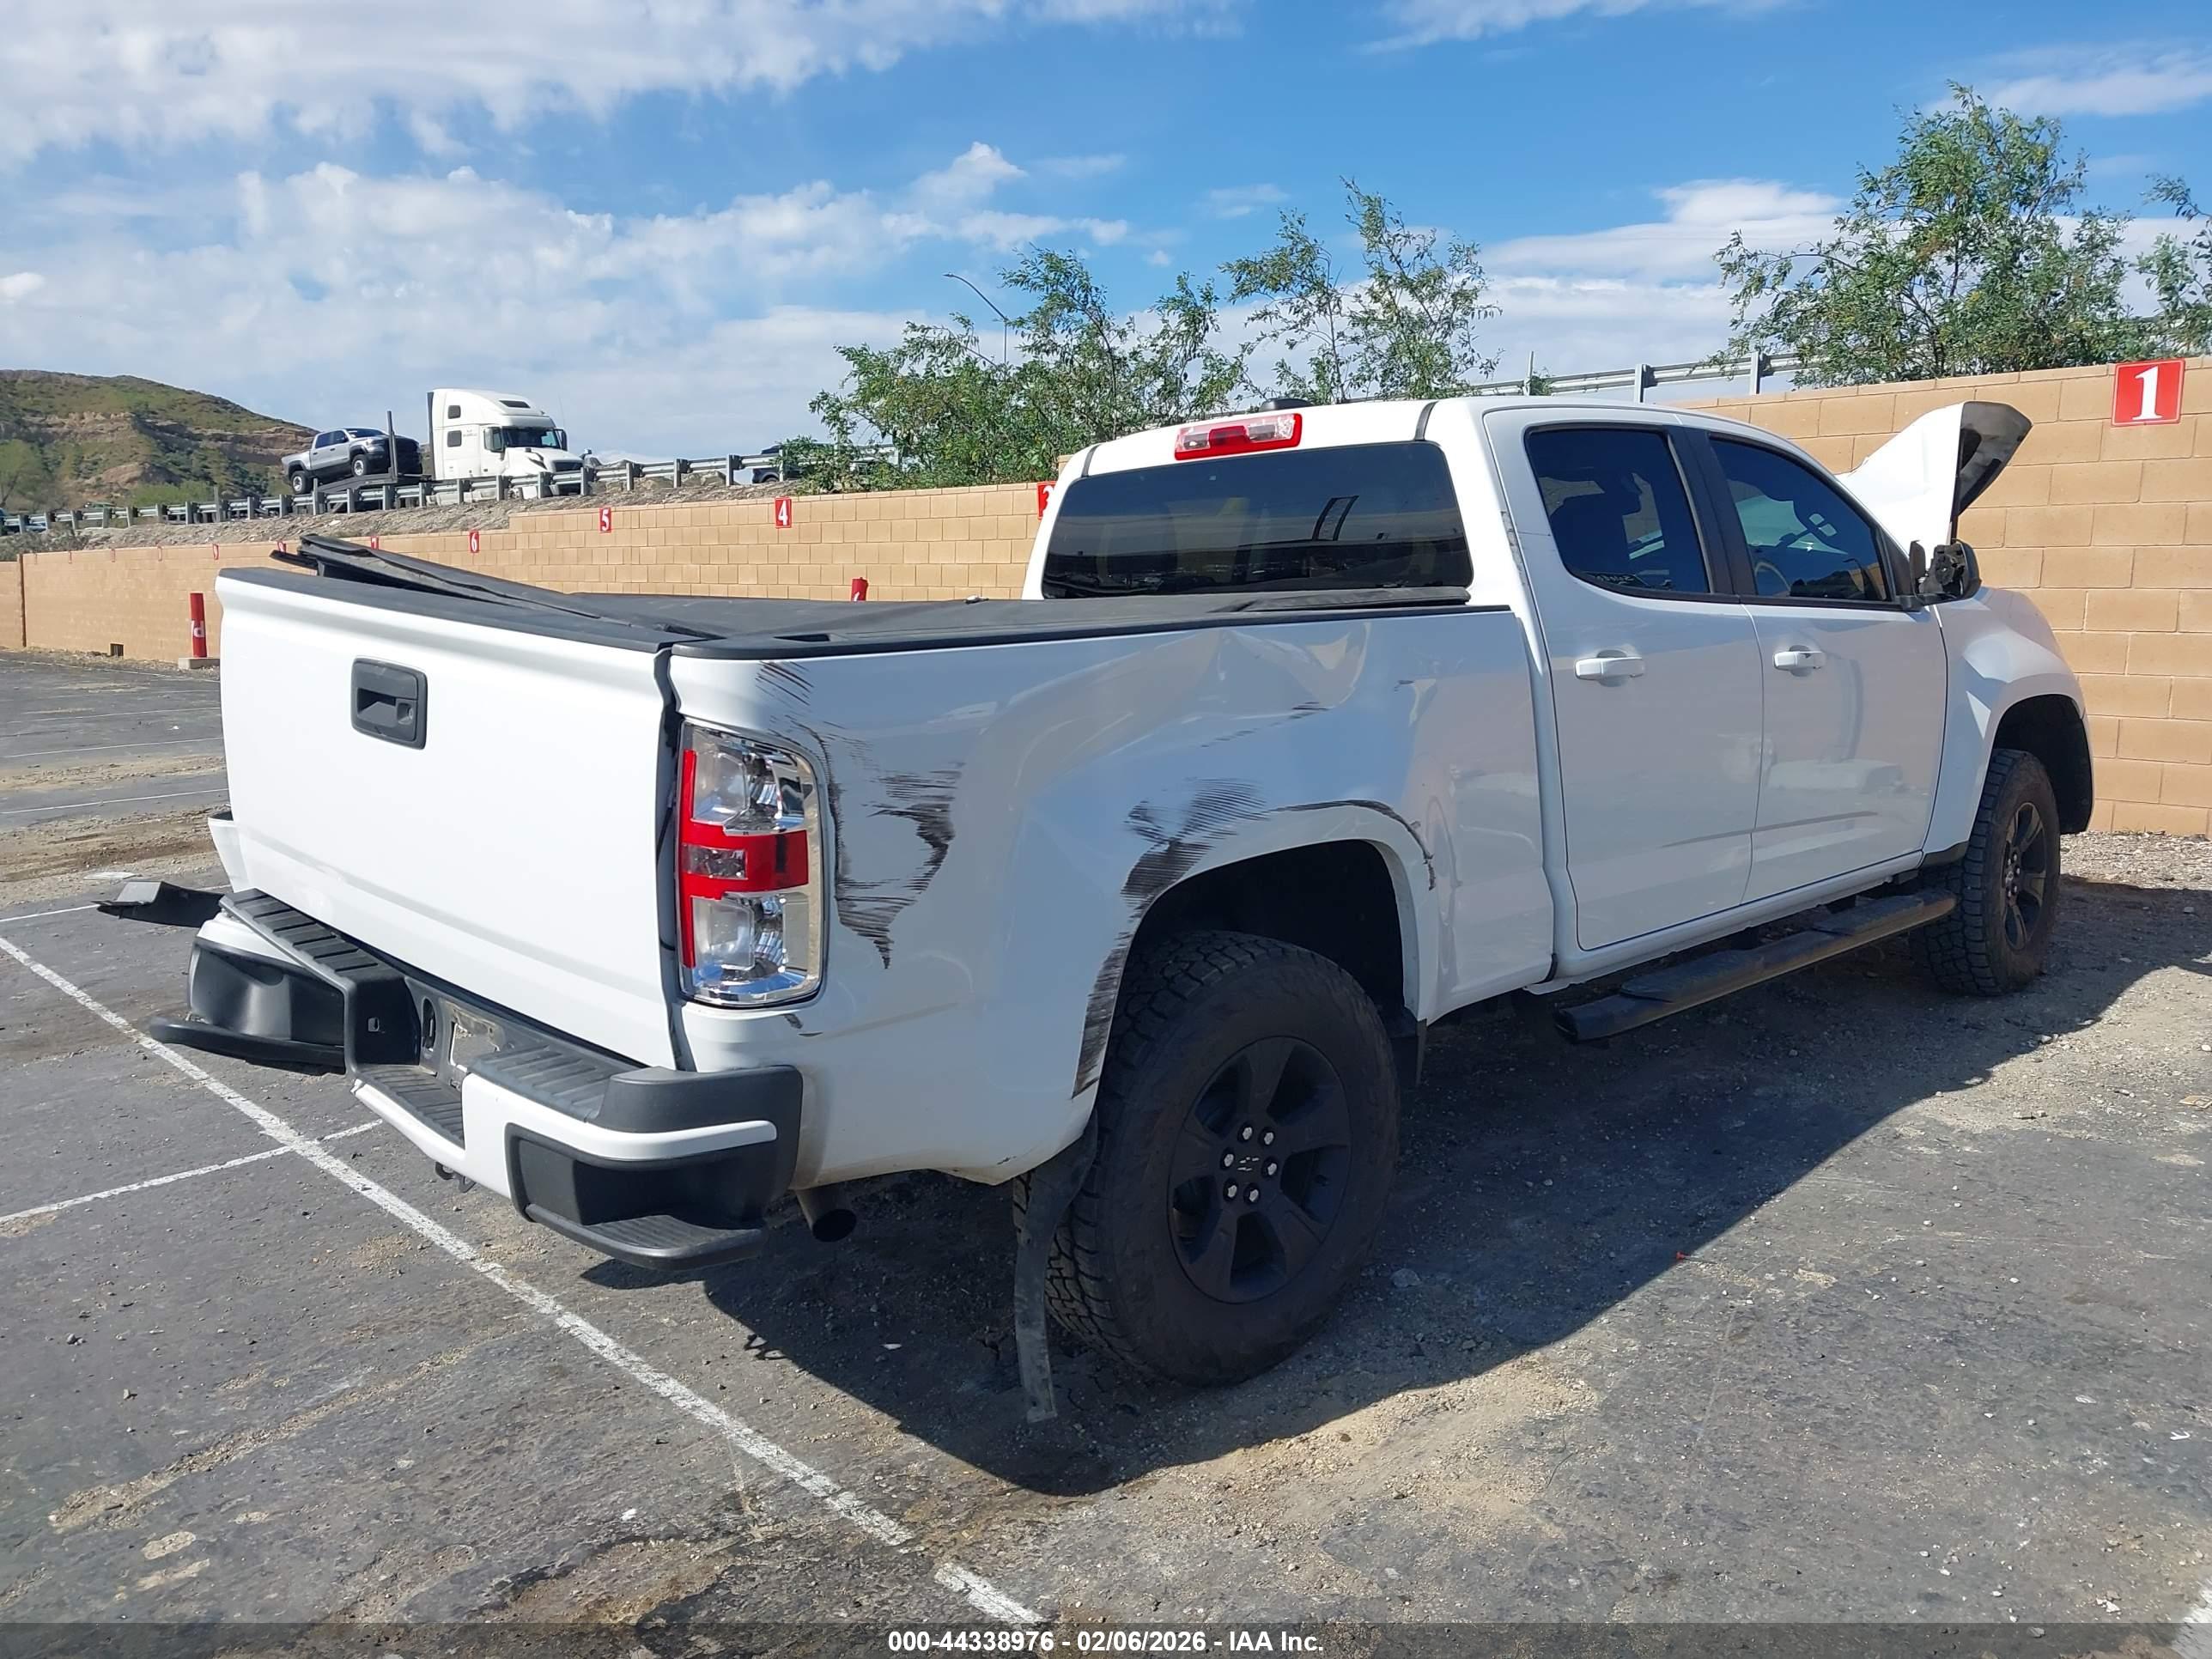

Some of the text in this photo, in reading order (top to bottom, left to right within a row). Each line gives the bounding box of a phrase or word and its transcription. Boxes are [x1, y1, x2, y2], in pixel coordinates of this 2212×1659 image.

[2132, 366, 2162, 420] 1
[601, 508, 610, 532] 5
[778, 500, 788, 526] 4
[471, 532, 477, 552] 6
